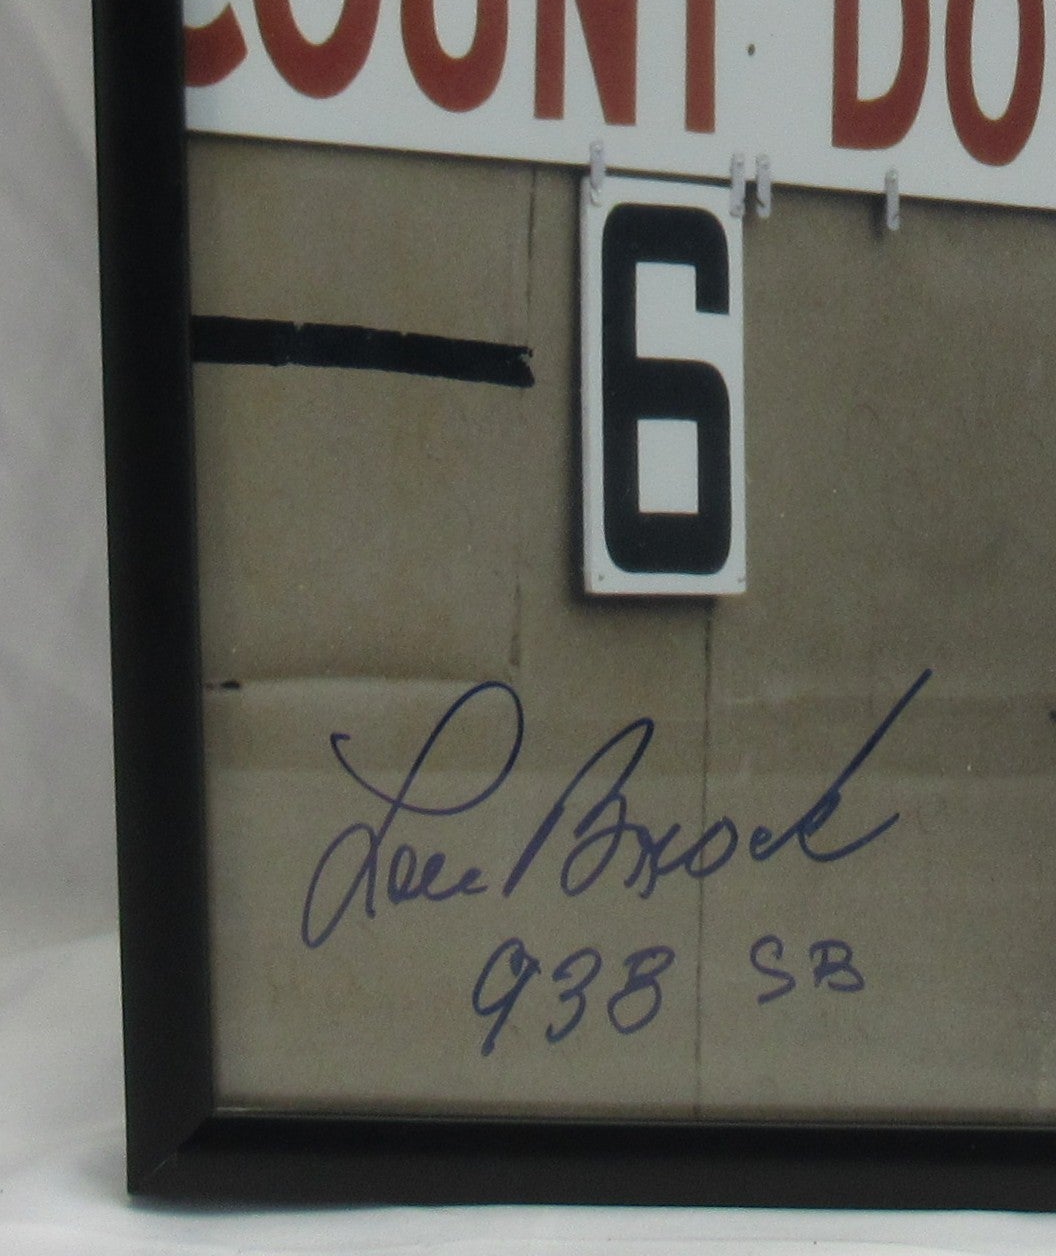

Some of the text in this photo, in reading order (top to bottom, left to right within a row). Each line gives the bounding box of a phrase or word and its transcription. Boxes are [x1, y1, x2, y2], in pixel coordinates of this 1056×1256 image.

[602, 202, 732, 576] 6
[504, 670, 932, 898] Brock
[471, 935, 865, 1056] 938 SB
